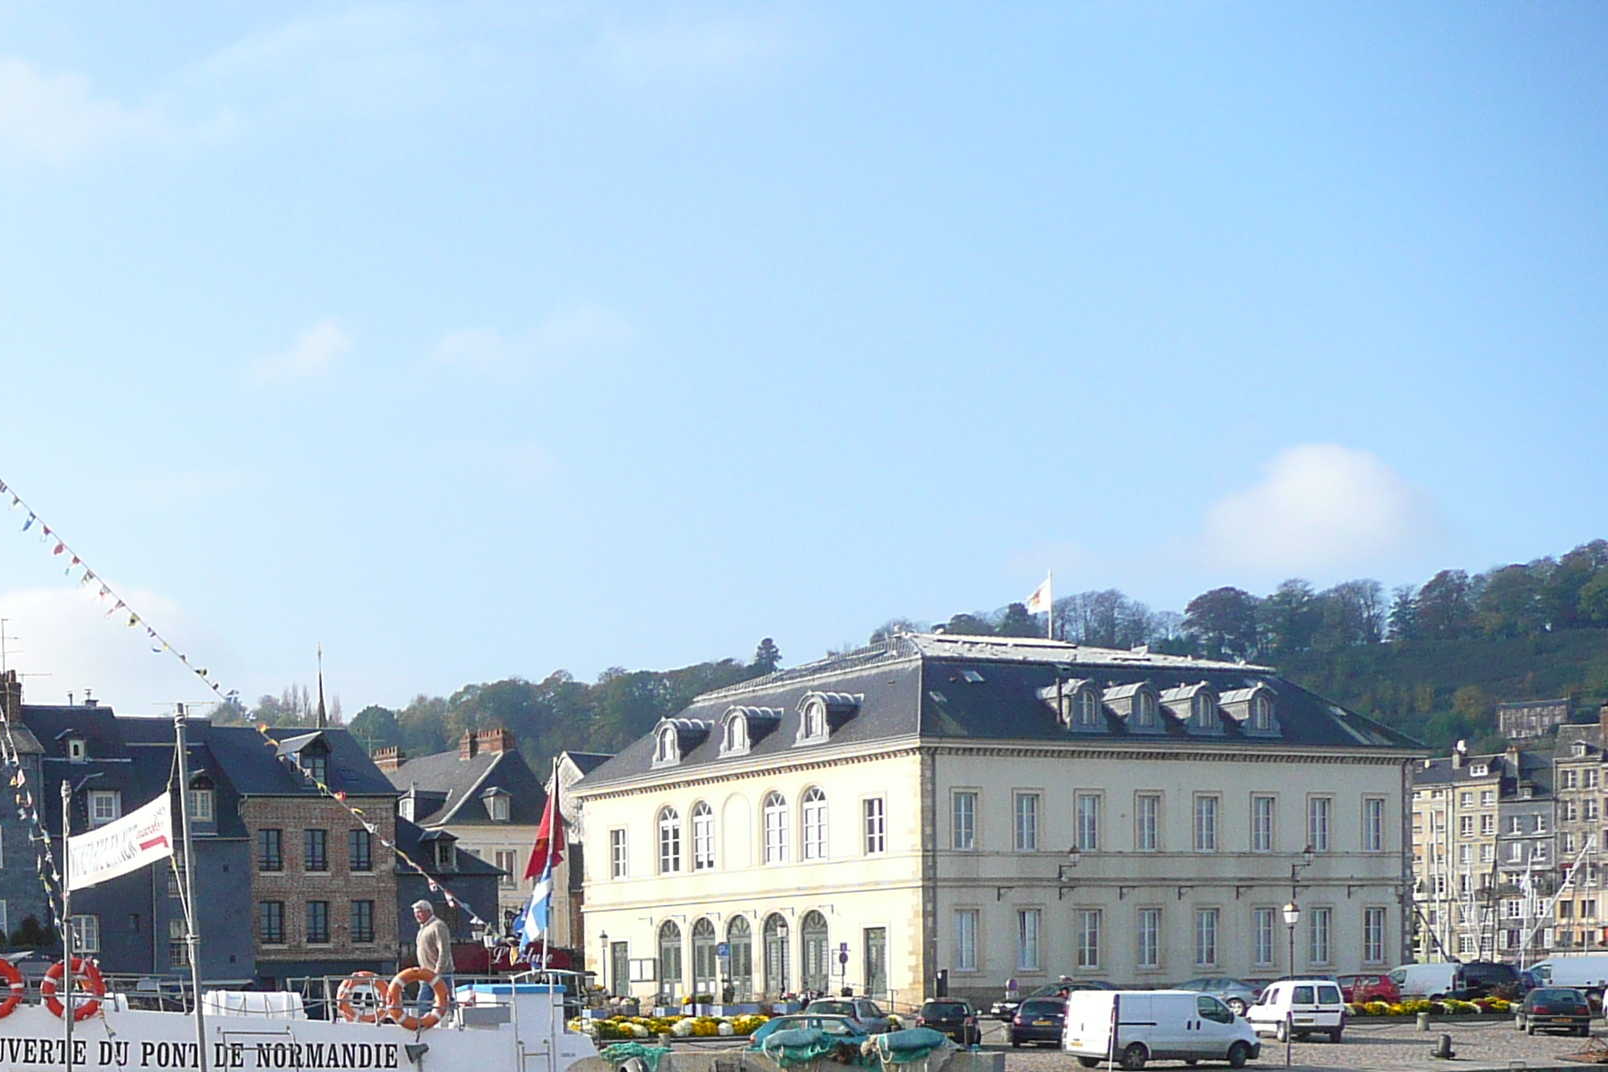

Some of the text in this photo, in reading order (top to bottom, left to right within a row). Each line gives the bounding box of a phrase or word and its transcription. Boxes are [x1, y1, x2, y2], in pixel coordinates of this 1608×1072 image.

[98, 1041, 130, 1066] DU
[140, 1042, 200, 1068] PONT
[214, 1043, 244, 1069] DE
[256, 1043, 398, 1069] NORMANDIE
